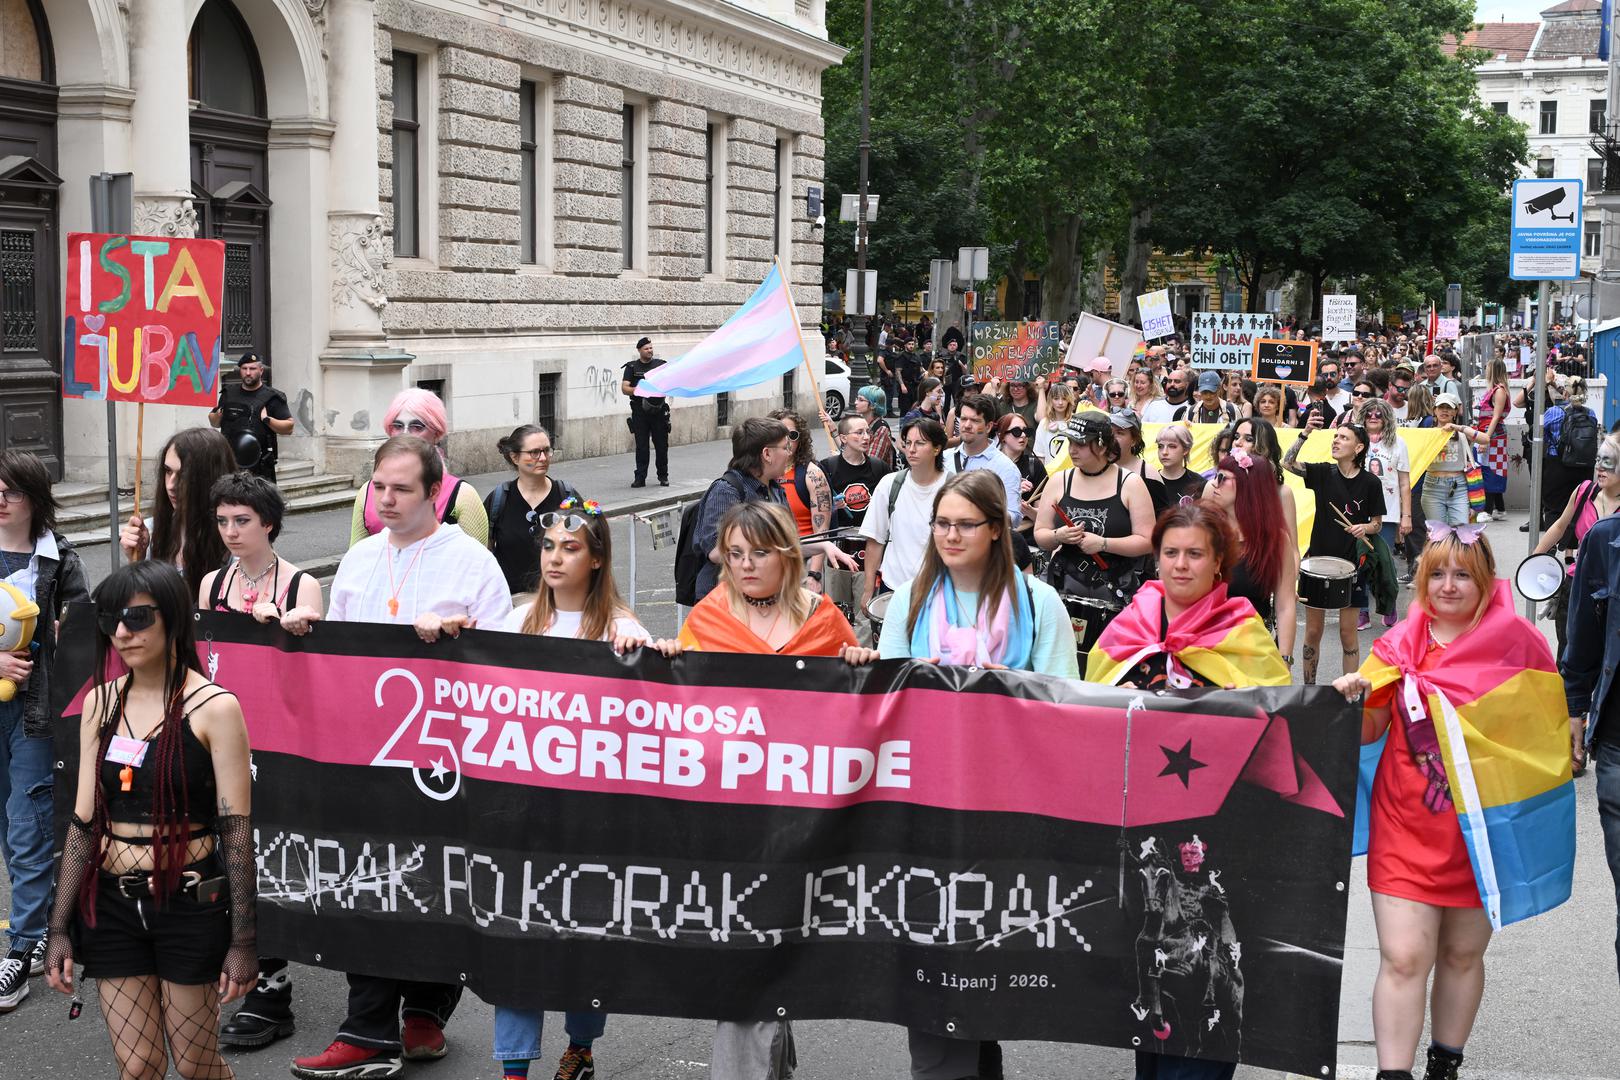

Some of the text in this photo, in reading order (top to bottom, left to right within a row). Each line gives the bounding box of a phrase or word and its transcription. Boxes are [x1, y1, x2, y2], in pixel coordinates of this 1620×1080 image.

[80, 236, 215, 318] ISTA
[64, 315, 220, 400] LJUBAV
[1027, 325, 1059, 340] NIJE
[1143, 315, 1172, 331] CISHET
[370, 667, 461, 801] 25
[434, 677, 767, 736] POVORKA PONOSA
[461, 714, 911, 796] ZAGREB PRIDE
[253, 828, 429, 914] KORAK
[443, 845, 505, 928] PO
[801, 864, 1093, 952] ISKORAK
[916, 968, 1057, 991] 6. lipanj 2026.
